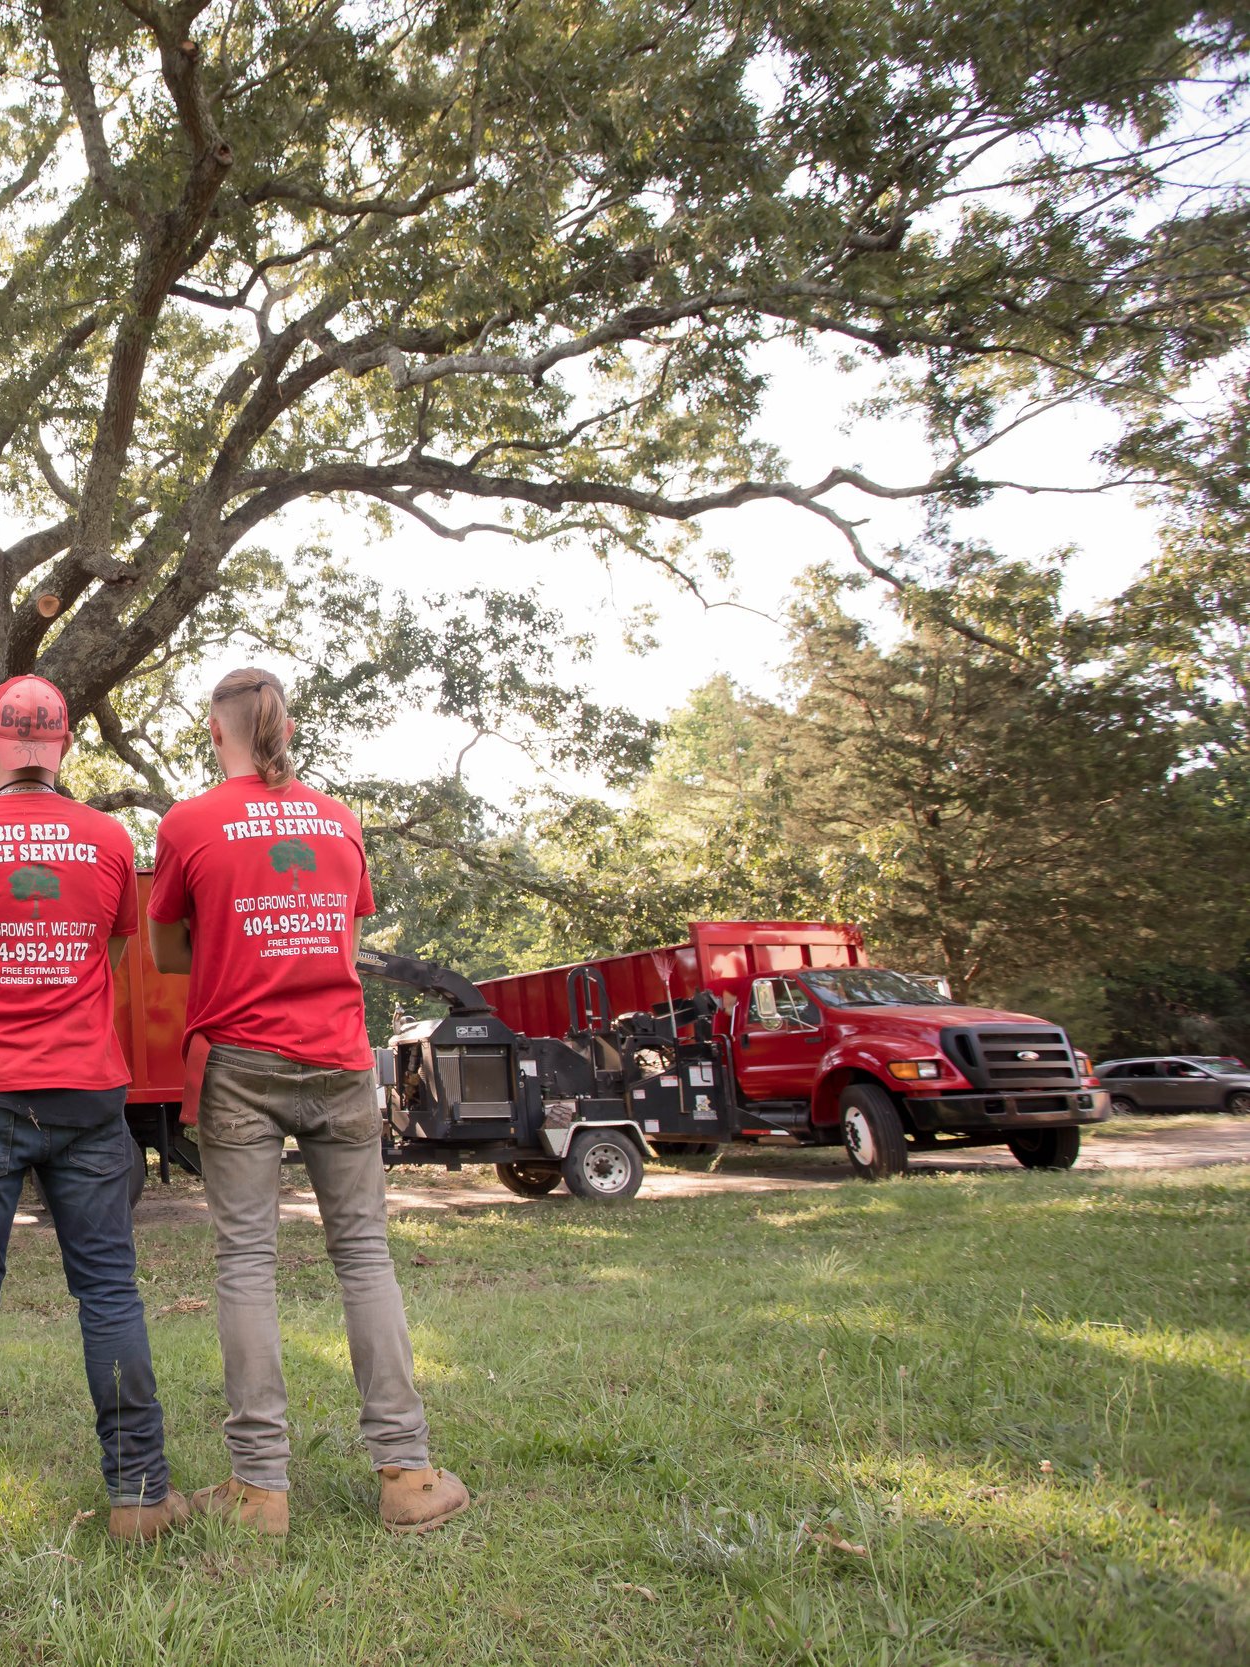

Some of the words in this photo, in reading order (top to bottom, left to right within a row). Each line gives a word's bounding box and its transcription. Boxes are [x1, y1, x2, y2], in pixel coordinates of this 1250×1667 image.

[1, 704, 31, 737] Big
[36, 706, 62, 730] Red
[245, 802, 279, 817] BIG
[281, 801, 318, 816] RED
[30, 824, 70, 841] RED
[223, 819, 272, 840] TREE
[274, 819, 344, 838] SERVICE
[19, 844, 97, 864] SERVICE
[234, 898, 255, 913] GOD
[258, 895, 295, 911] GROWS
[298, 894, 309, 909] IT,
[310, 893, 326, 907] WE
[327, 893, 342, 907] CUT
[36, 922, 49, 938] IT,
[50, 922, 68, 936] WE
[69, 923, 88, 937] CUT
[267, 937, 287, 947] FREE
[289, 936, 330, 946] ESTIMATES
[260, 948, 300, 958] LICENSED
[302, 947, 308, 955] &
[309, 946, 339, 955] INSURED
[1, 966, 22, 974] FREE
[24, 966, 70, 975] ESTIMATES
[35, 976, 42, 984] &
[44, 975, 77, 984] INSURED
